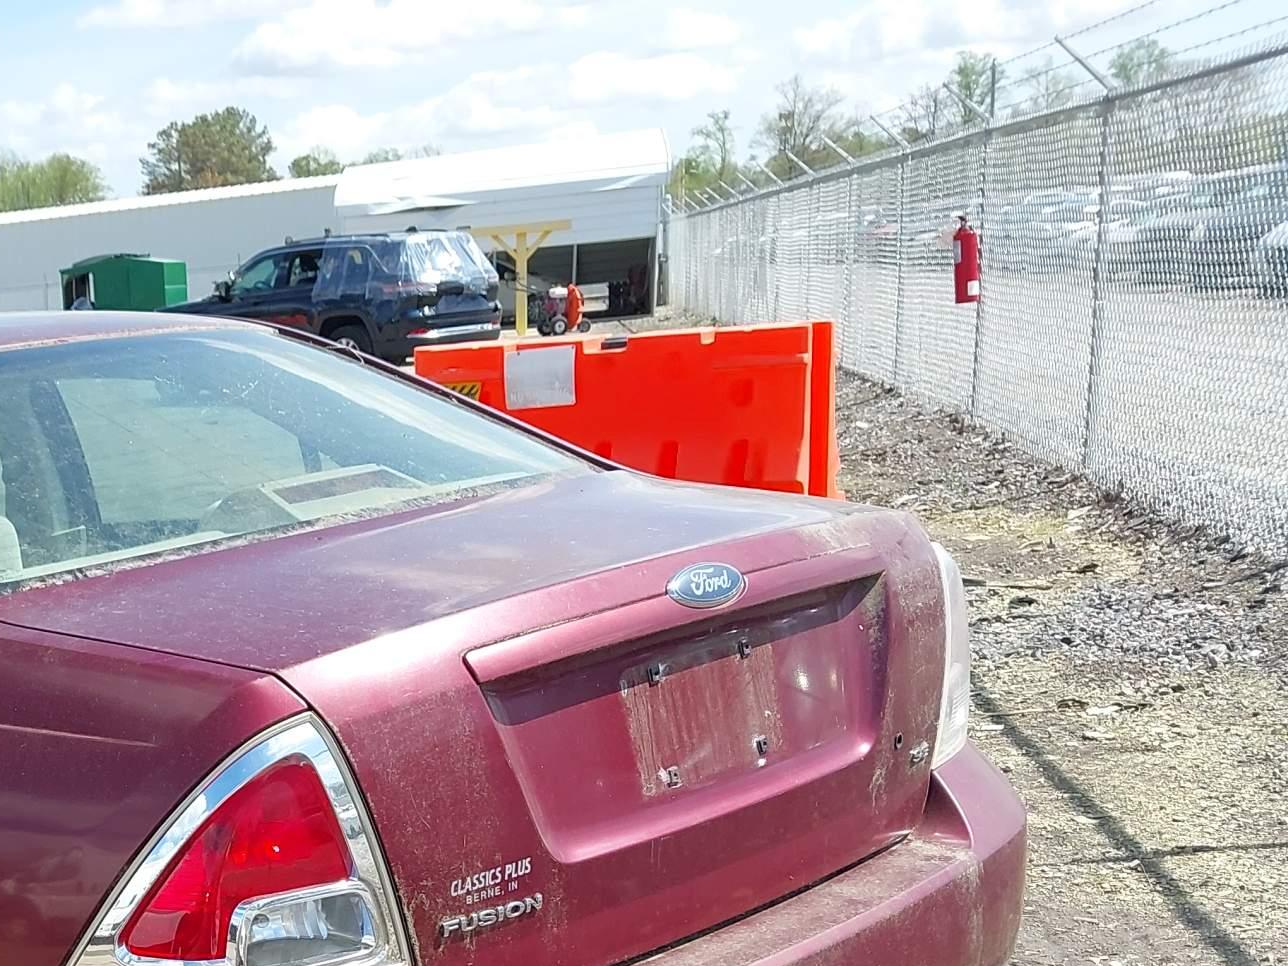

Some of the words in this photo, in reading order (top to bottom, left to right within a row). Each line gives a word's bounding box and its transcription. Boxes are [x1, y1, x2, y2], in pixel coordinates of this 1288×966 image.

[690, 567, 731, 596] Ford
[450, 867, 502, 897] CLASSICS
[504, 857, 532, 881] PLUS
[465, 885, 505, 905] BERNE,
[508, 880, 518, 892] IN
[442, 892, 544, 938] FUSION
